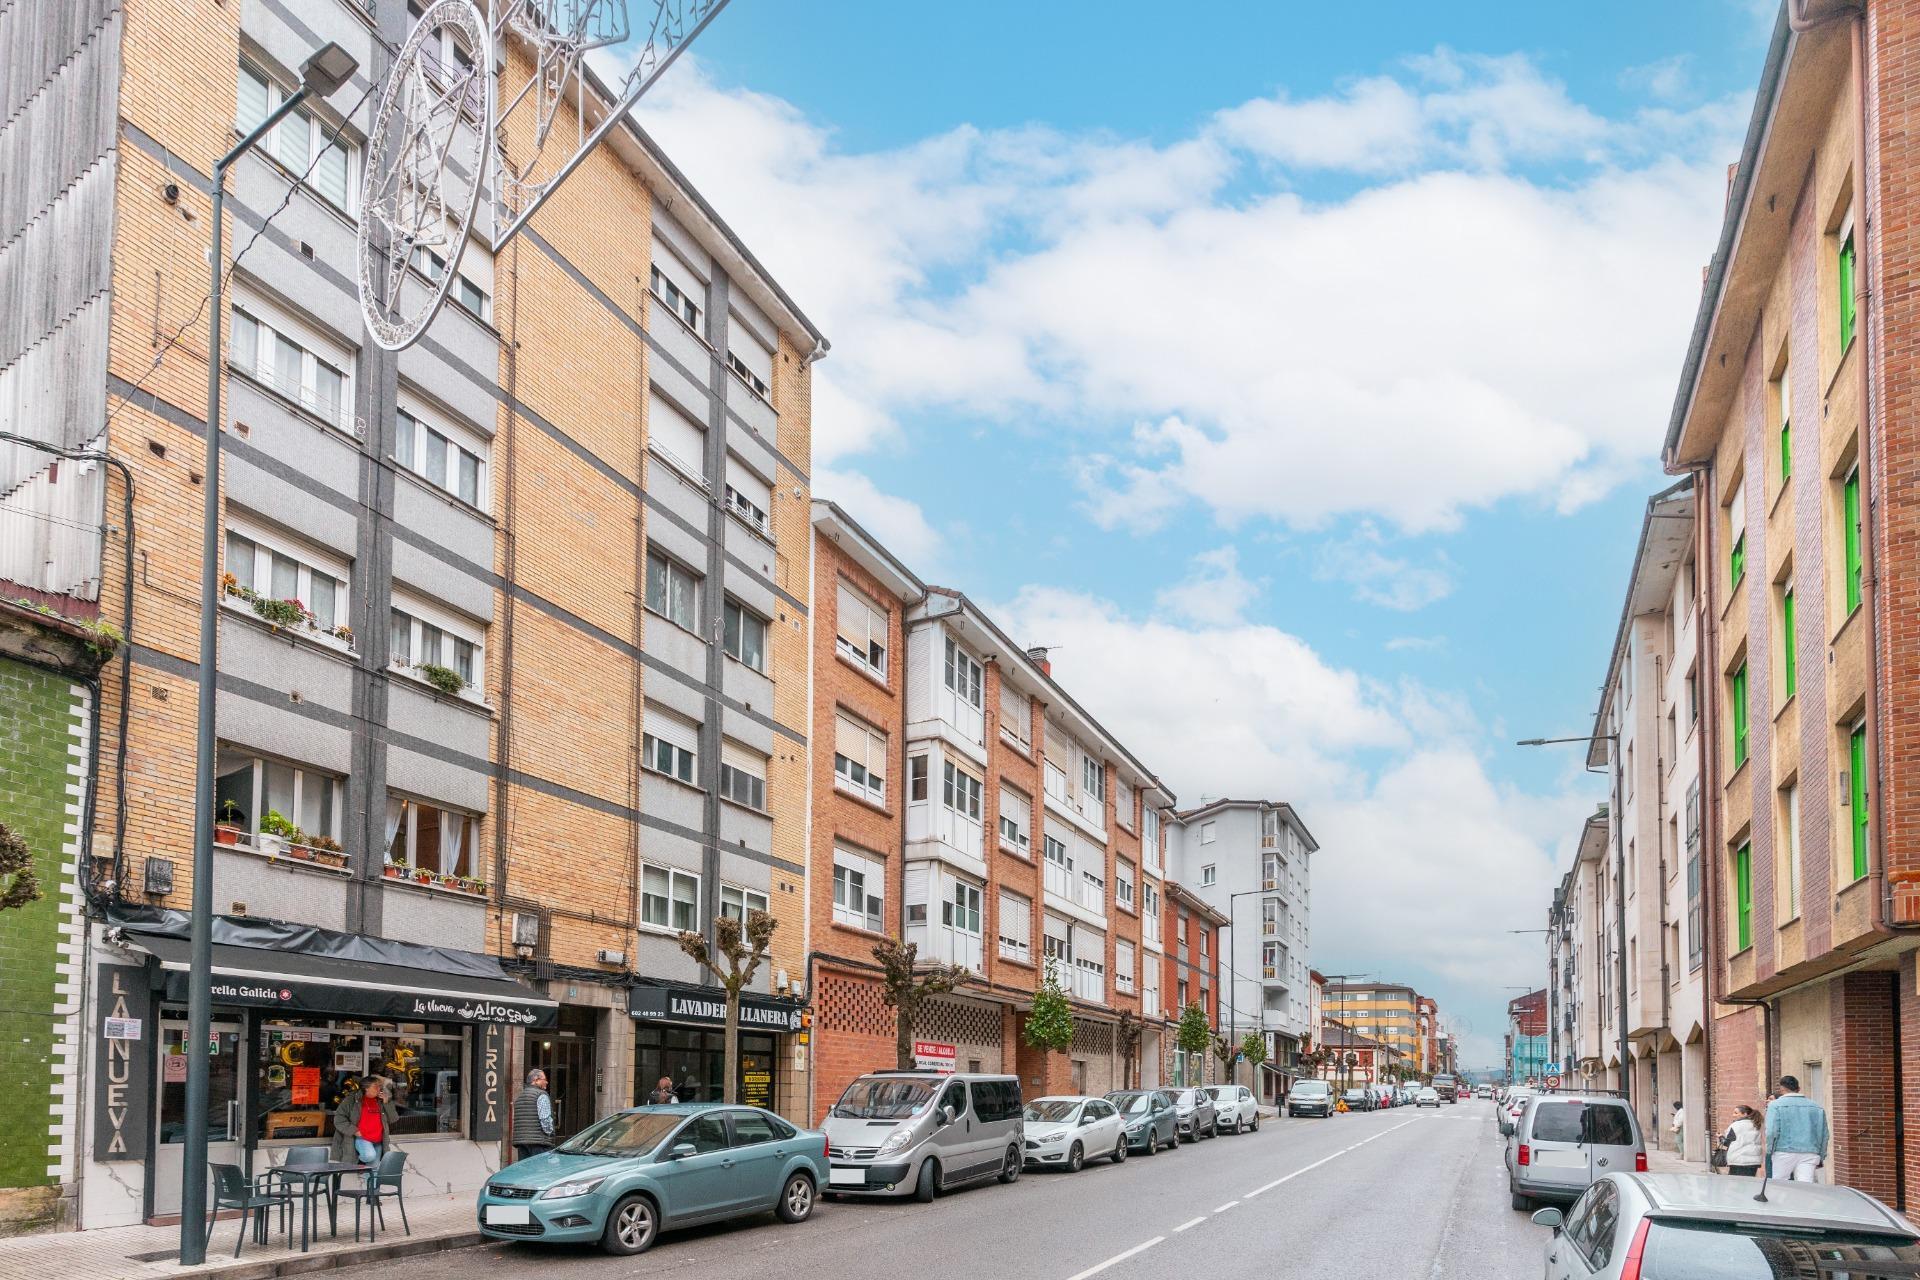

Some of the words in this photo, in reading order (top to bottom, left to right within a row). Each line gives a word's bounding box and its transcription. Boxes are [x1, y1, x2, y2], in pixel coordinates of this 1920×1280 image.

[211, 985, 237, 996] rella
[239, 986, 278, 999] Galicia
[413, 999, 426, 1014] La
[427, 999, 456, 1014] Nueva
[473, 1001, 522, 1022] Alroca
[671, 997, 728, 1019] LAVADER
[740, 1006, 789, 1026] LLANERA
[484, 1023, 498, 1122] ALROCA
[108, 1037, 130, 1153] NUEVA
